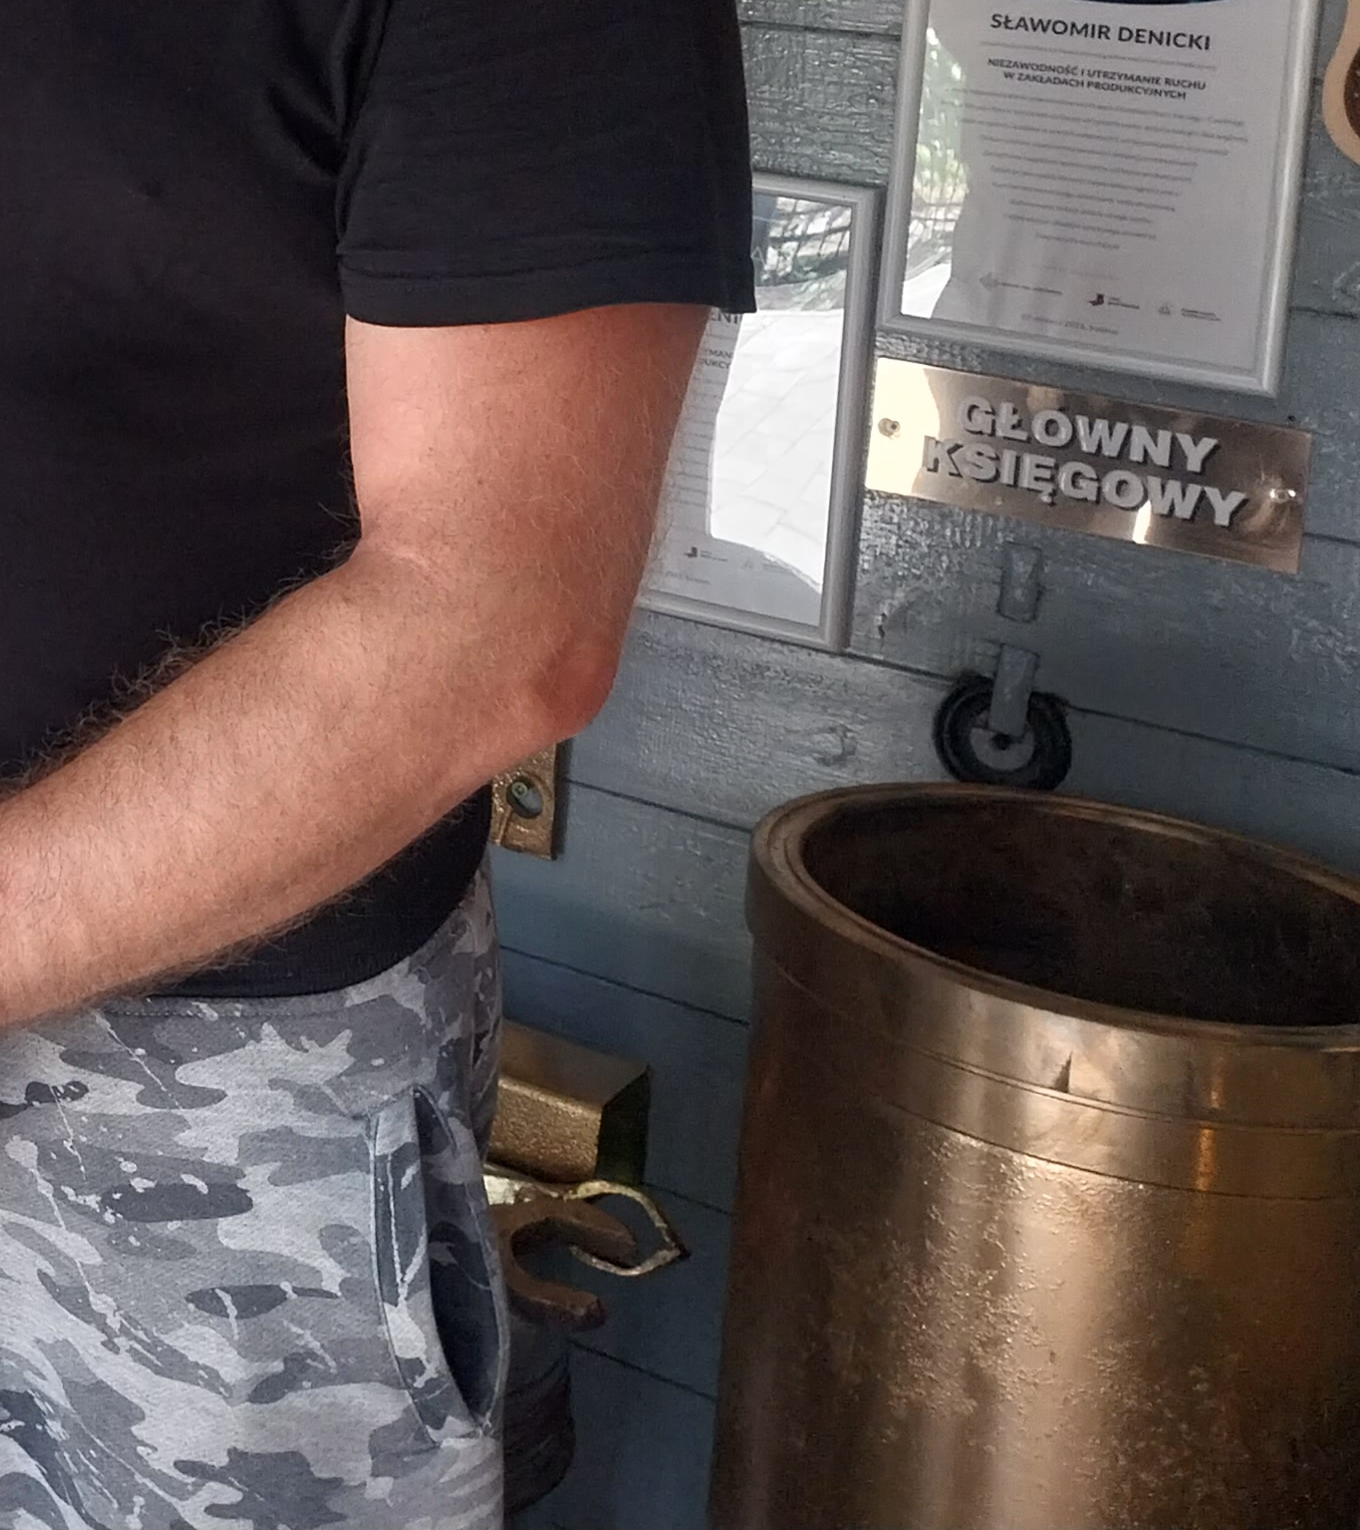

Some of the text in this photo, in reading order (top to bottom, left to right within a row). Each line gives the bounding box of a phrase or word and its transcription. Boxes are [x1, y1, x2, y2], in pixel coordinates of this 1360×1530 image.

[990, 13, 1211, 51] SŁAWOMIR DENICKI
[987, 57, 1079, 77] NIEZAWODNOŚĆ
[1087, 69, 1162, 86] UTRZYMANIE
[1164, 77, 1206, 91] RUCHU
[1004, 71, 1187, 100] W ZAKŁADACH PRODUKCYJNYCH
[923, 435, 1245, 527] KSIĘGOWY
